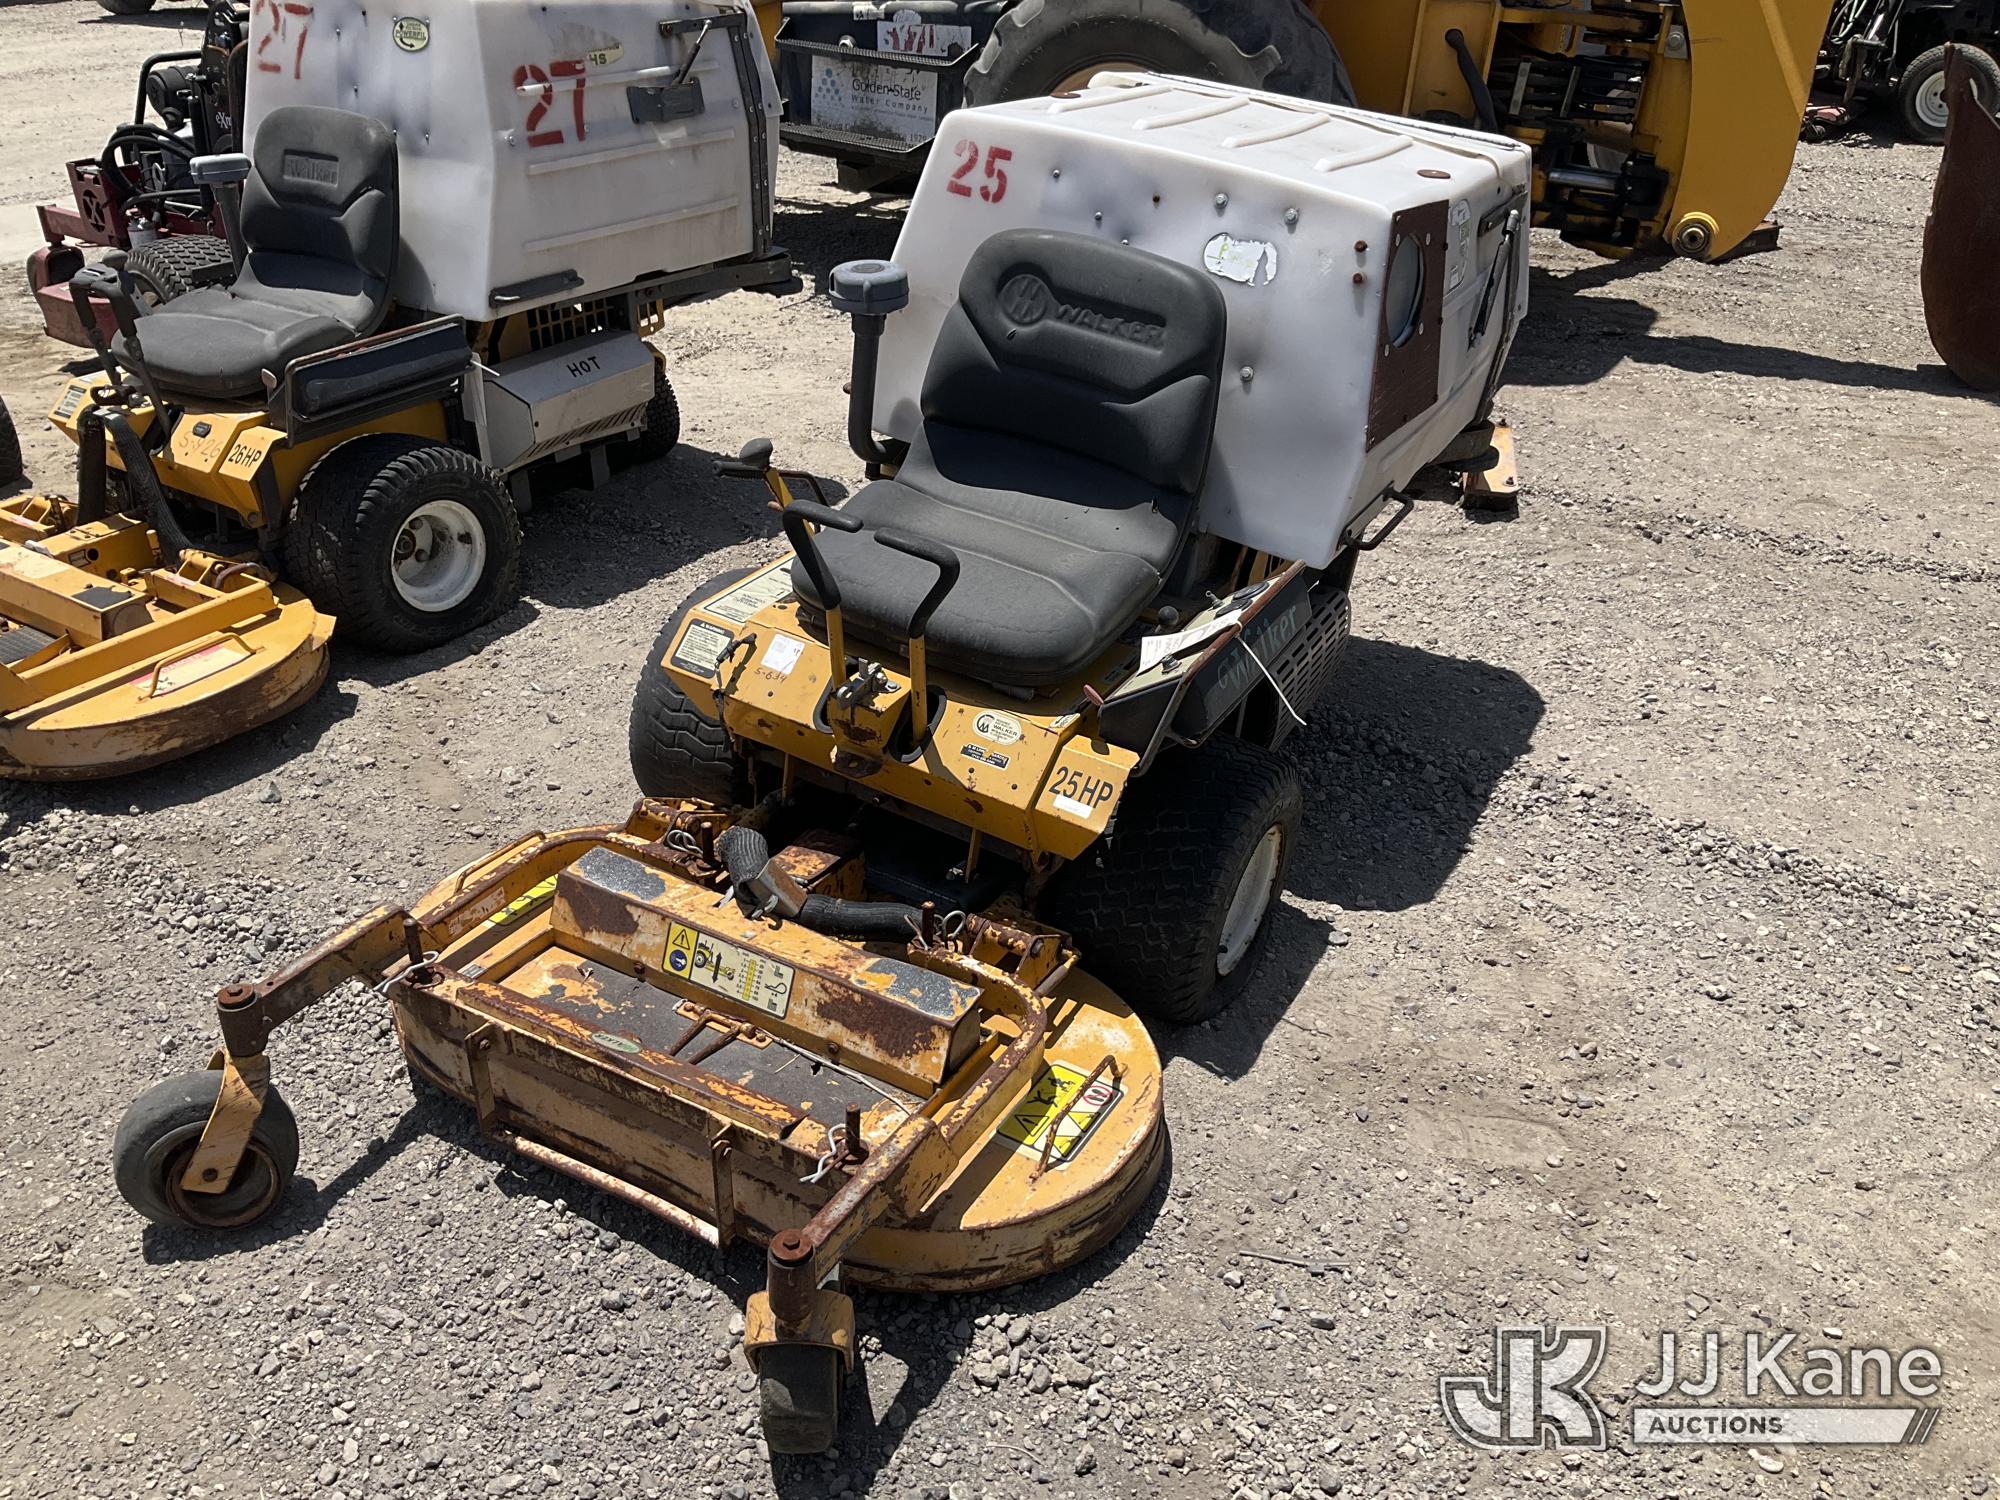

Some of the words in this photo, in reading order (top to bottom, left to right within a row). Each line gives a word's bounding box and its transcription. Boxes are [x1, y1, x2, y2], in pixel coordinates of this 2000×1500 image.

[254, 0, 312, 80] 27
[513, 58, 586, 148] 27
[851, 93, 879, 105] Water
[885, 100, 928, 114] Company
[852, 78, 890, 95] Golden
[893, 83, 922, 101] State
[946, 139, 1012, 204] 25
[1055, 303, 1166, 348] WALKER
[566, 356, 600, 378] HOT
[228, 443, 263, 469] 26HP
[993, 724, 1018, 737] WALKER
[1048, 765, 1114, 809] 25HP
